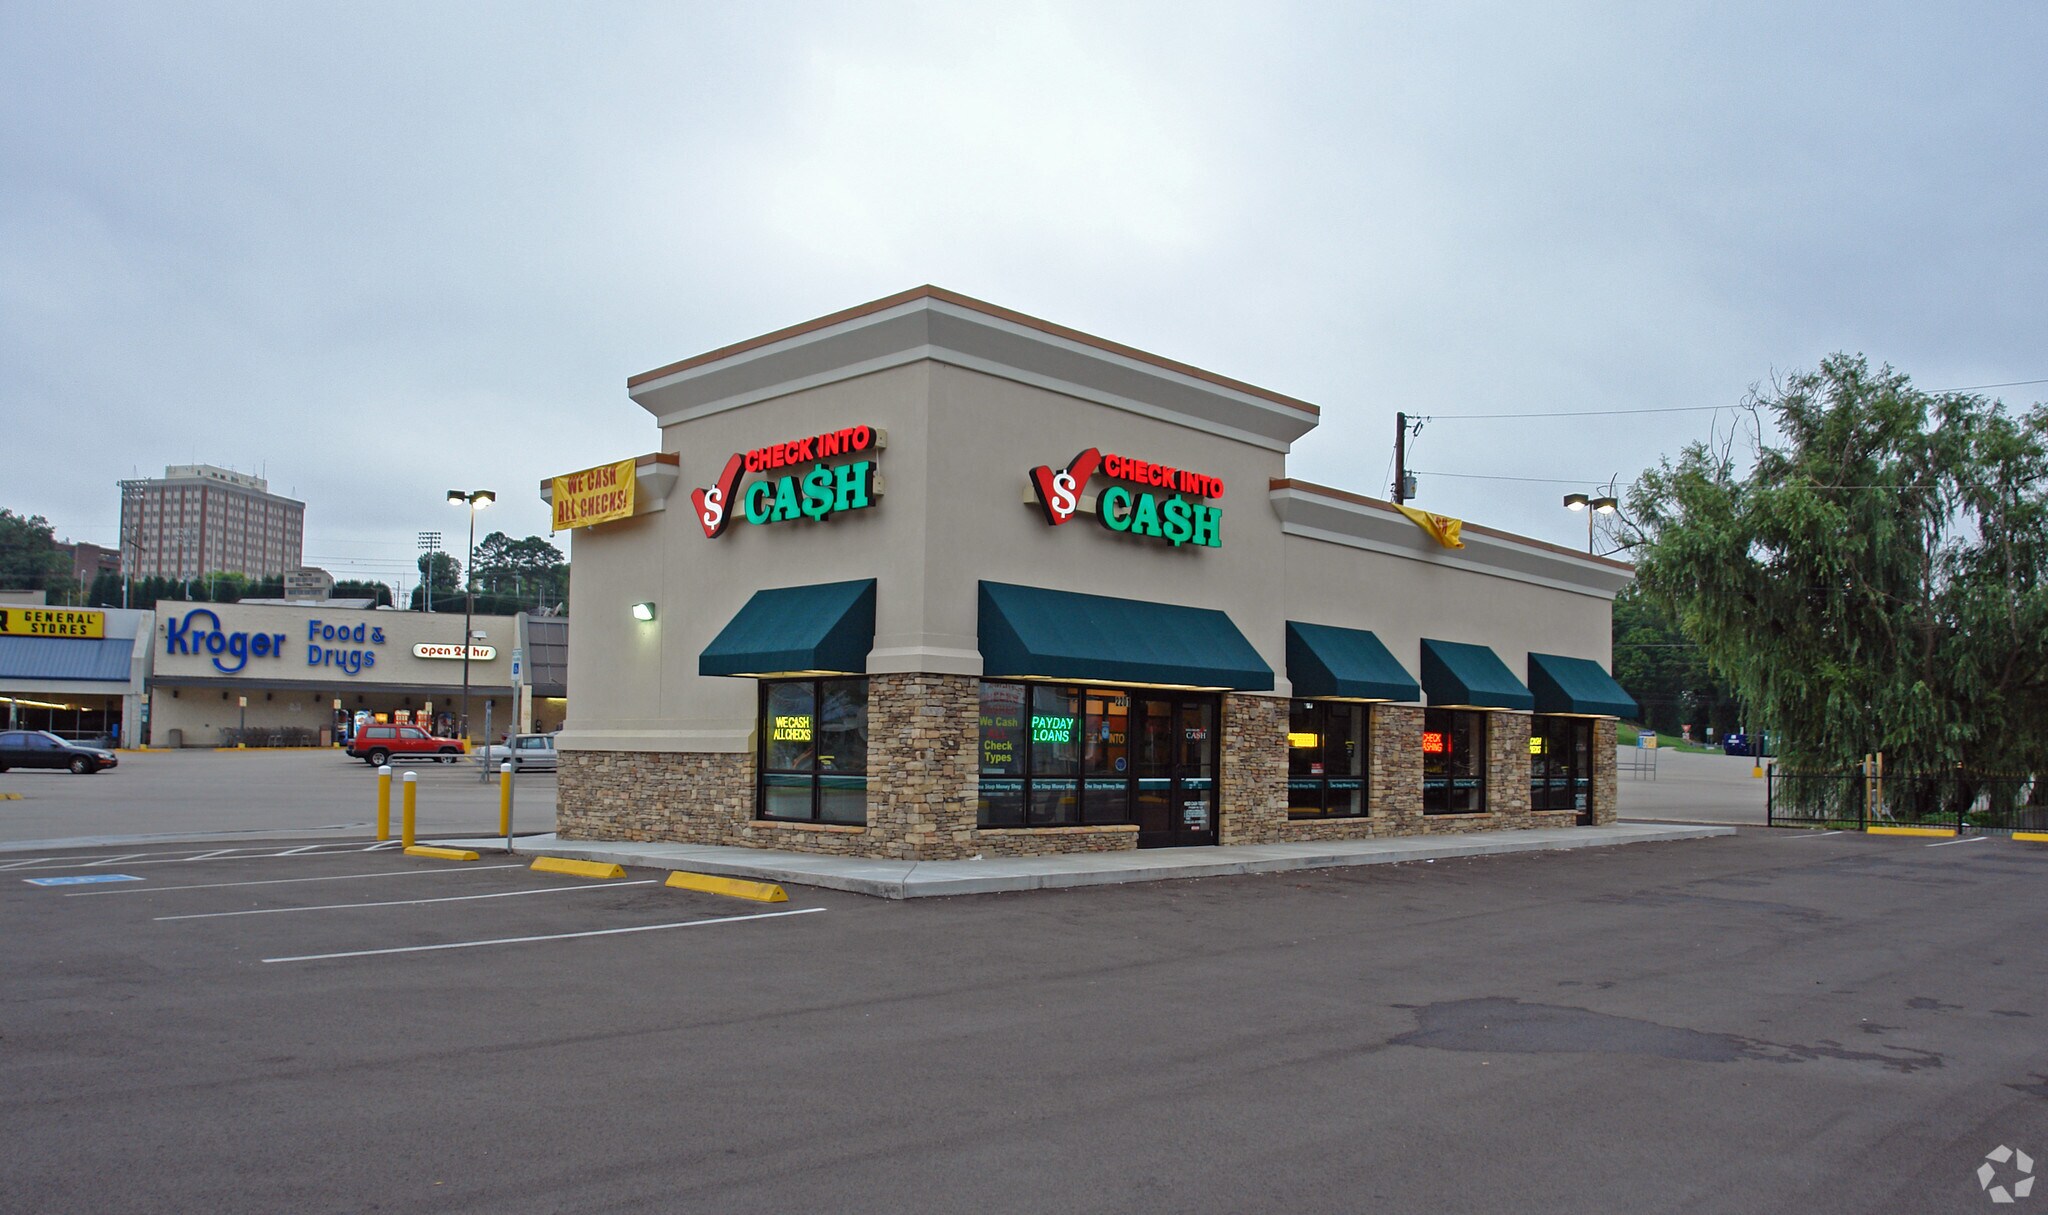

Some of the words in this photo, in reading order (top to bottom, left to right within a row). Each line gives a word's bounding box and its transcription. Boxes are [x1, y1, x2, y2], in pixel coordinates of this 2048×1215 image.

[745, 436, 815, 473] CHECK
[817, 424, 871, 458] INTO
[567, 474, 585, 495] WE
[587, 465, 617, 491] CASH
[1103, 453, 1177, 489] CHECK
[1180, 470, 1224, 499] INTO
[744, 460, 870, 526] CA$H
[557, 499, 576, 523] ALL
[580, 488, 628, 518] CHECKS!
[1102, 485, 1222, 548] CA$H
[24, 611, 93, 625] GENERAL
[31, 623, 87, 635] STORES
[308, 619, 366, 644] Food
[371, 626, 385, 644] &
[166, 608, 286, 674] Kroger
[420, 646, 451, 657] open
[472, 647, 490, 657] hrs
[308, 644, 375, 676] Drugs
[775, 716, 788, 728] WE
[788, 716, 810, 728] CASH
[980, 716, 993, 726] We
[995, 716, 1018, 727] Cash
[1031, 716, 1074, 729] PAYDAY
[773, 728, 785, 740] ALL
[785, 728, 812, 741] CHECKS
[1033, 729, 1070, 742] LOANS
[984, 740, 1013, 751] Check
[984, 752, 1012, 764] Types
